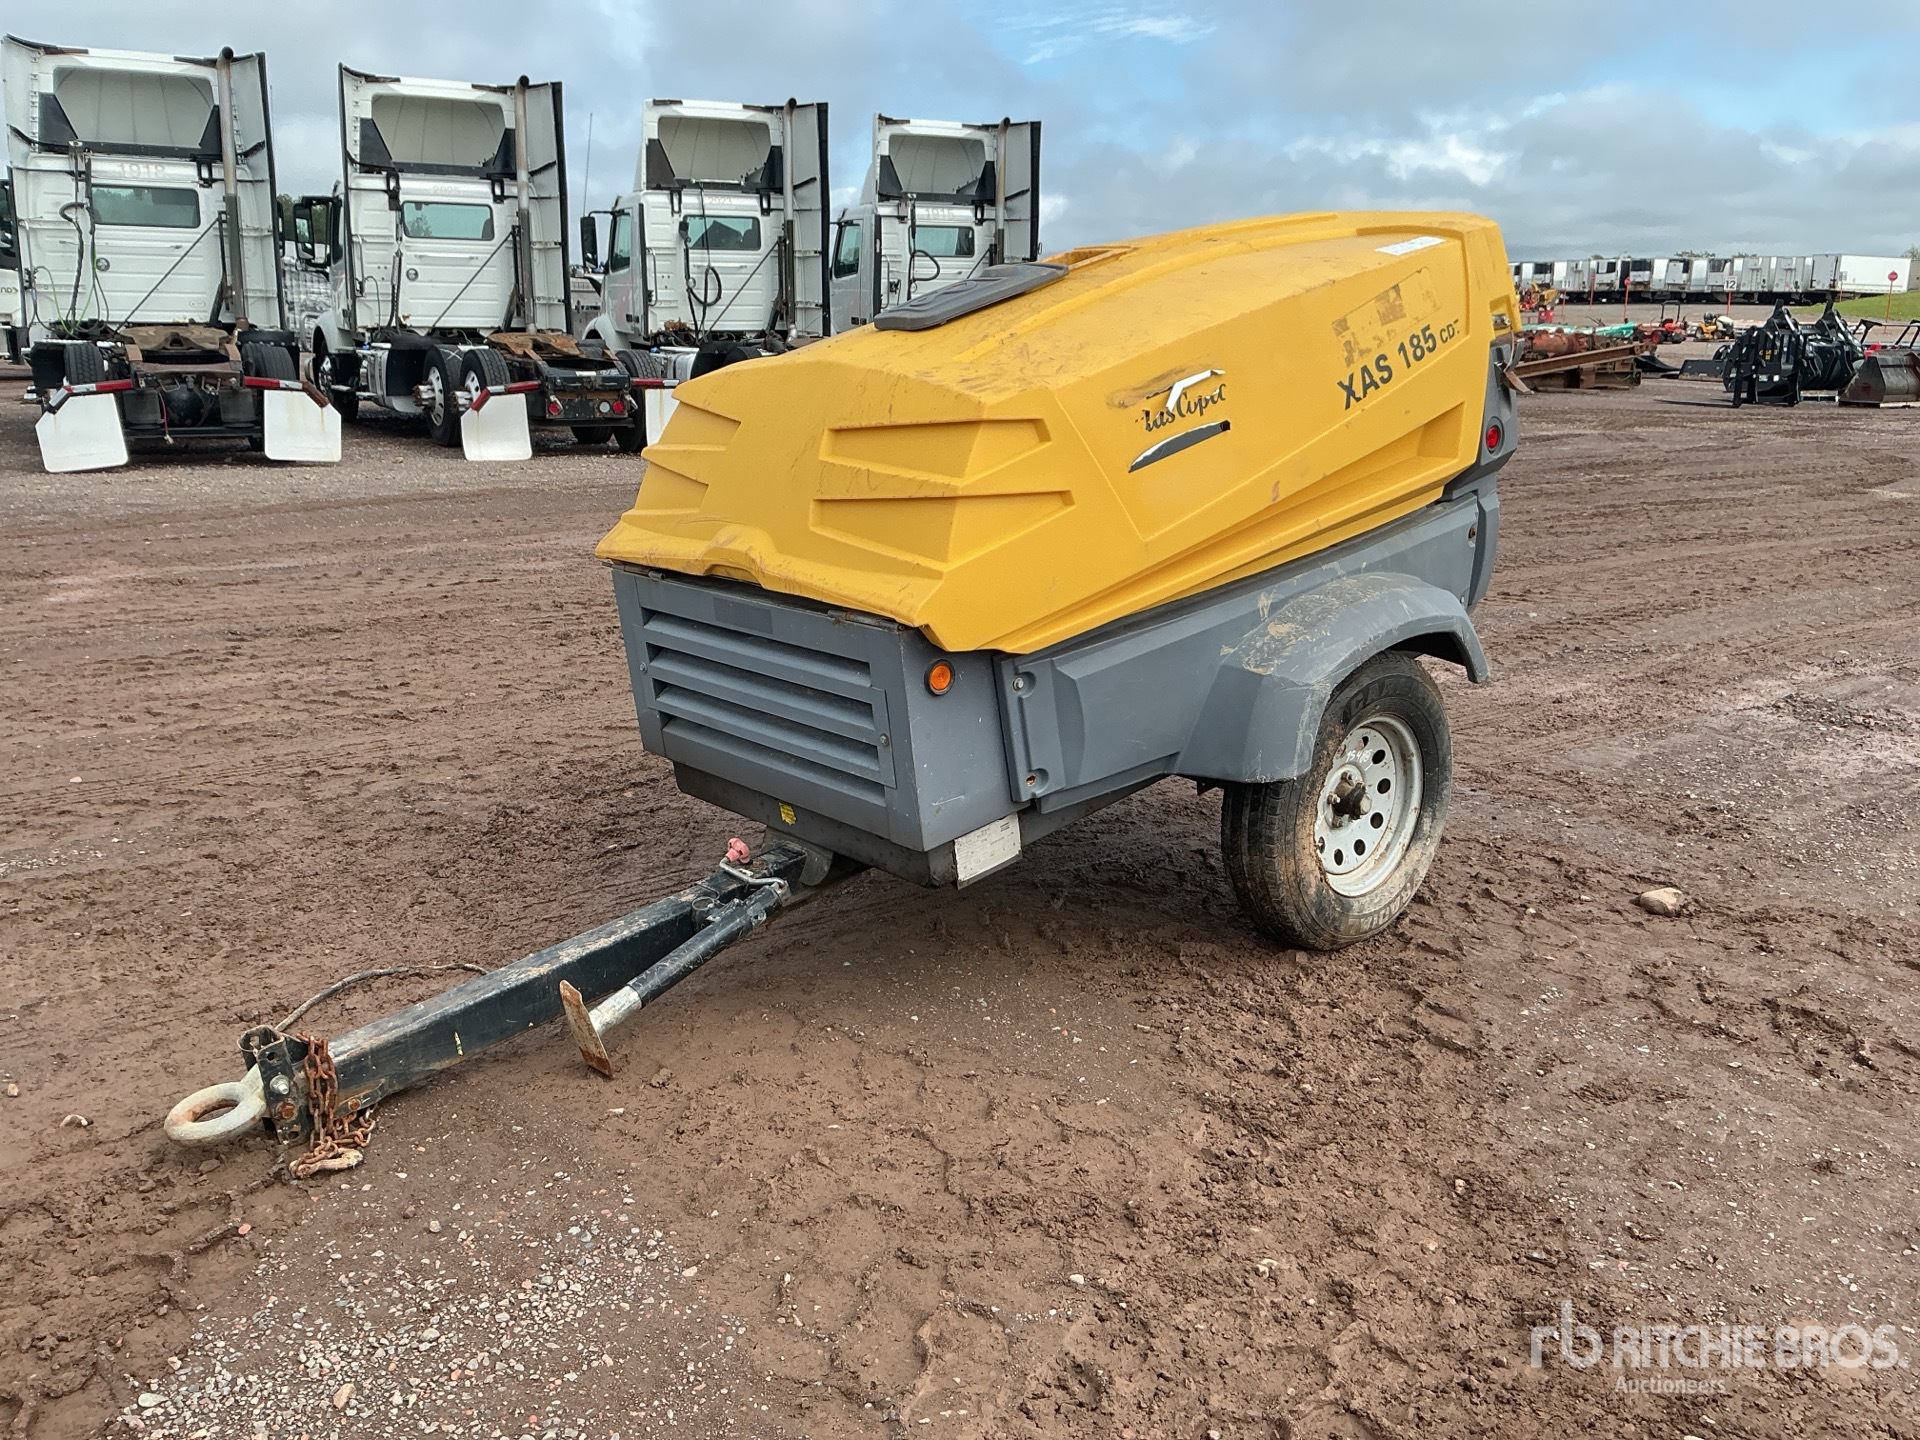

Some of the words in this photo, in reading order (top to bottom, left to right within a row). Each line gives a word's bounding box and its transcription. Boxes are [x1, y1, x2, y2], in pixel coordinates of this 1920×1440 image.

[1725, 280, 1736, 289] 12
[1336, 353, 1394, 411] XAS
[1397, 324, 1437, 369] 185
